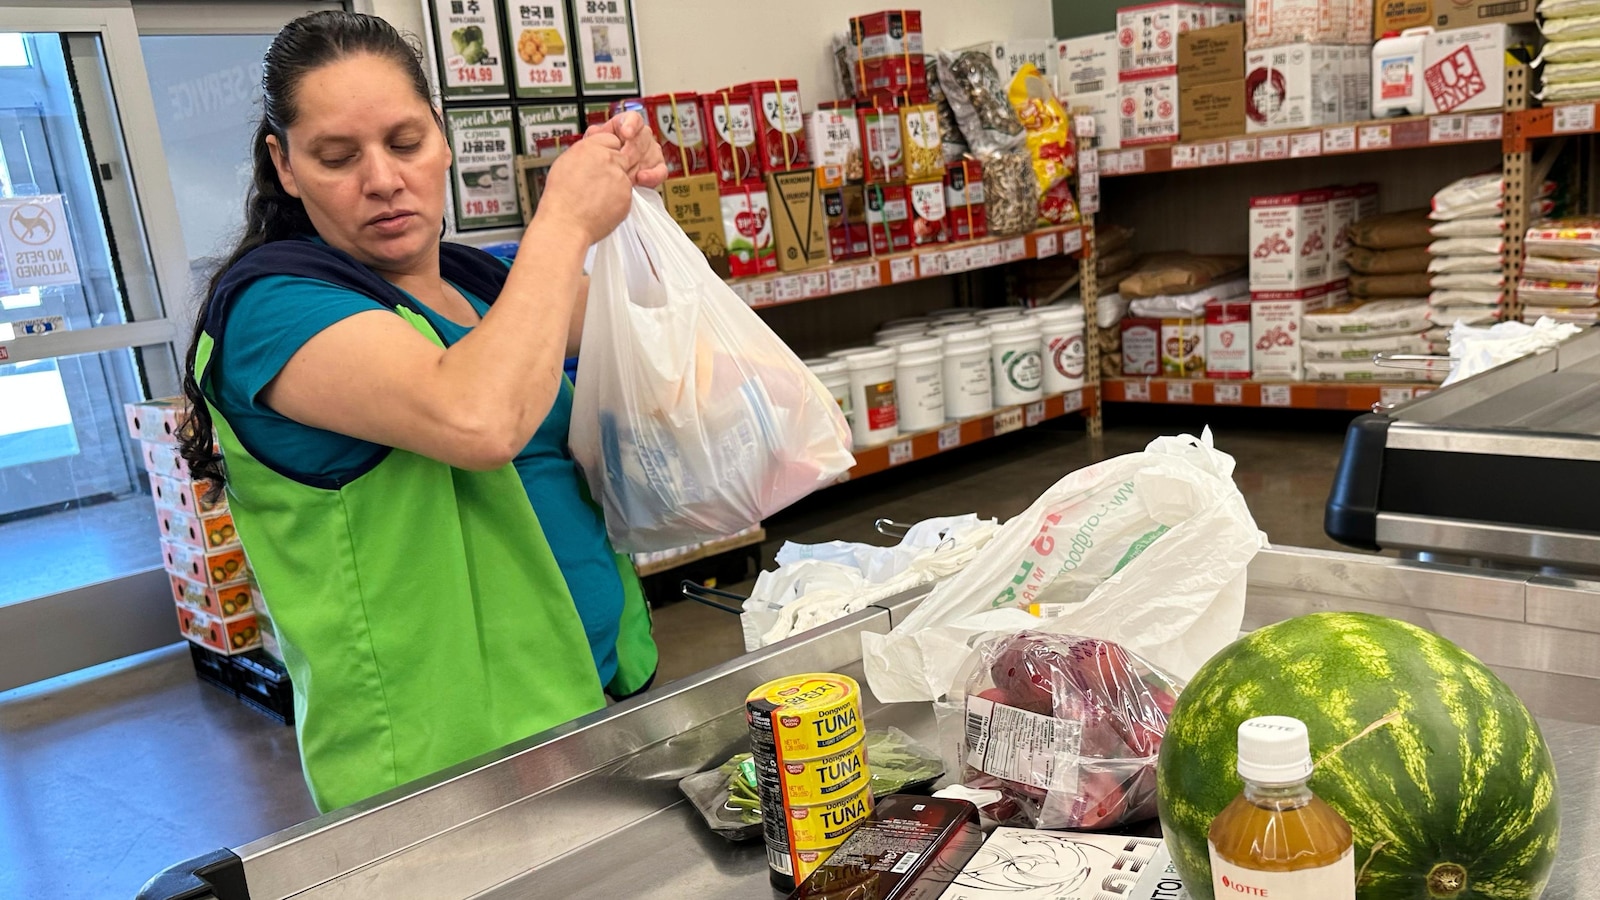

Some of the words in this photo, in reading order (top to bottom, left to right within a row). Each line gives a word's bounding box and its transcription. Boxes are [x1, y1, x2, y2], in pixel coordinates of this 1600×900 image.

[458, 67, 493, 82] $14.99
[530, 68, 563, 83] $32.99
[596, 66, 622, 80] $7.99
[449, 111, 488, 130] Special
[490, 108, 512, 124] Sale
[466, 199, 500, 215] $10.99
[818, 702, 851, 717] Dongwon
[812, 708, 857, 737] TUNA
[1247, 722, 1296, 731] LOTTE
[816, 754, 861, 783] TUNA
[820, 799, 865, 828] TUNA
[1230, 881, 1269, 898] LOTTE
